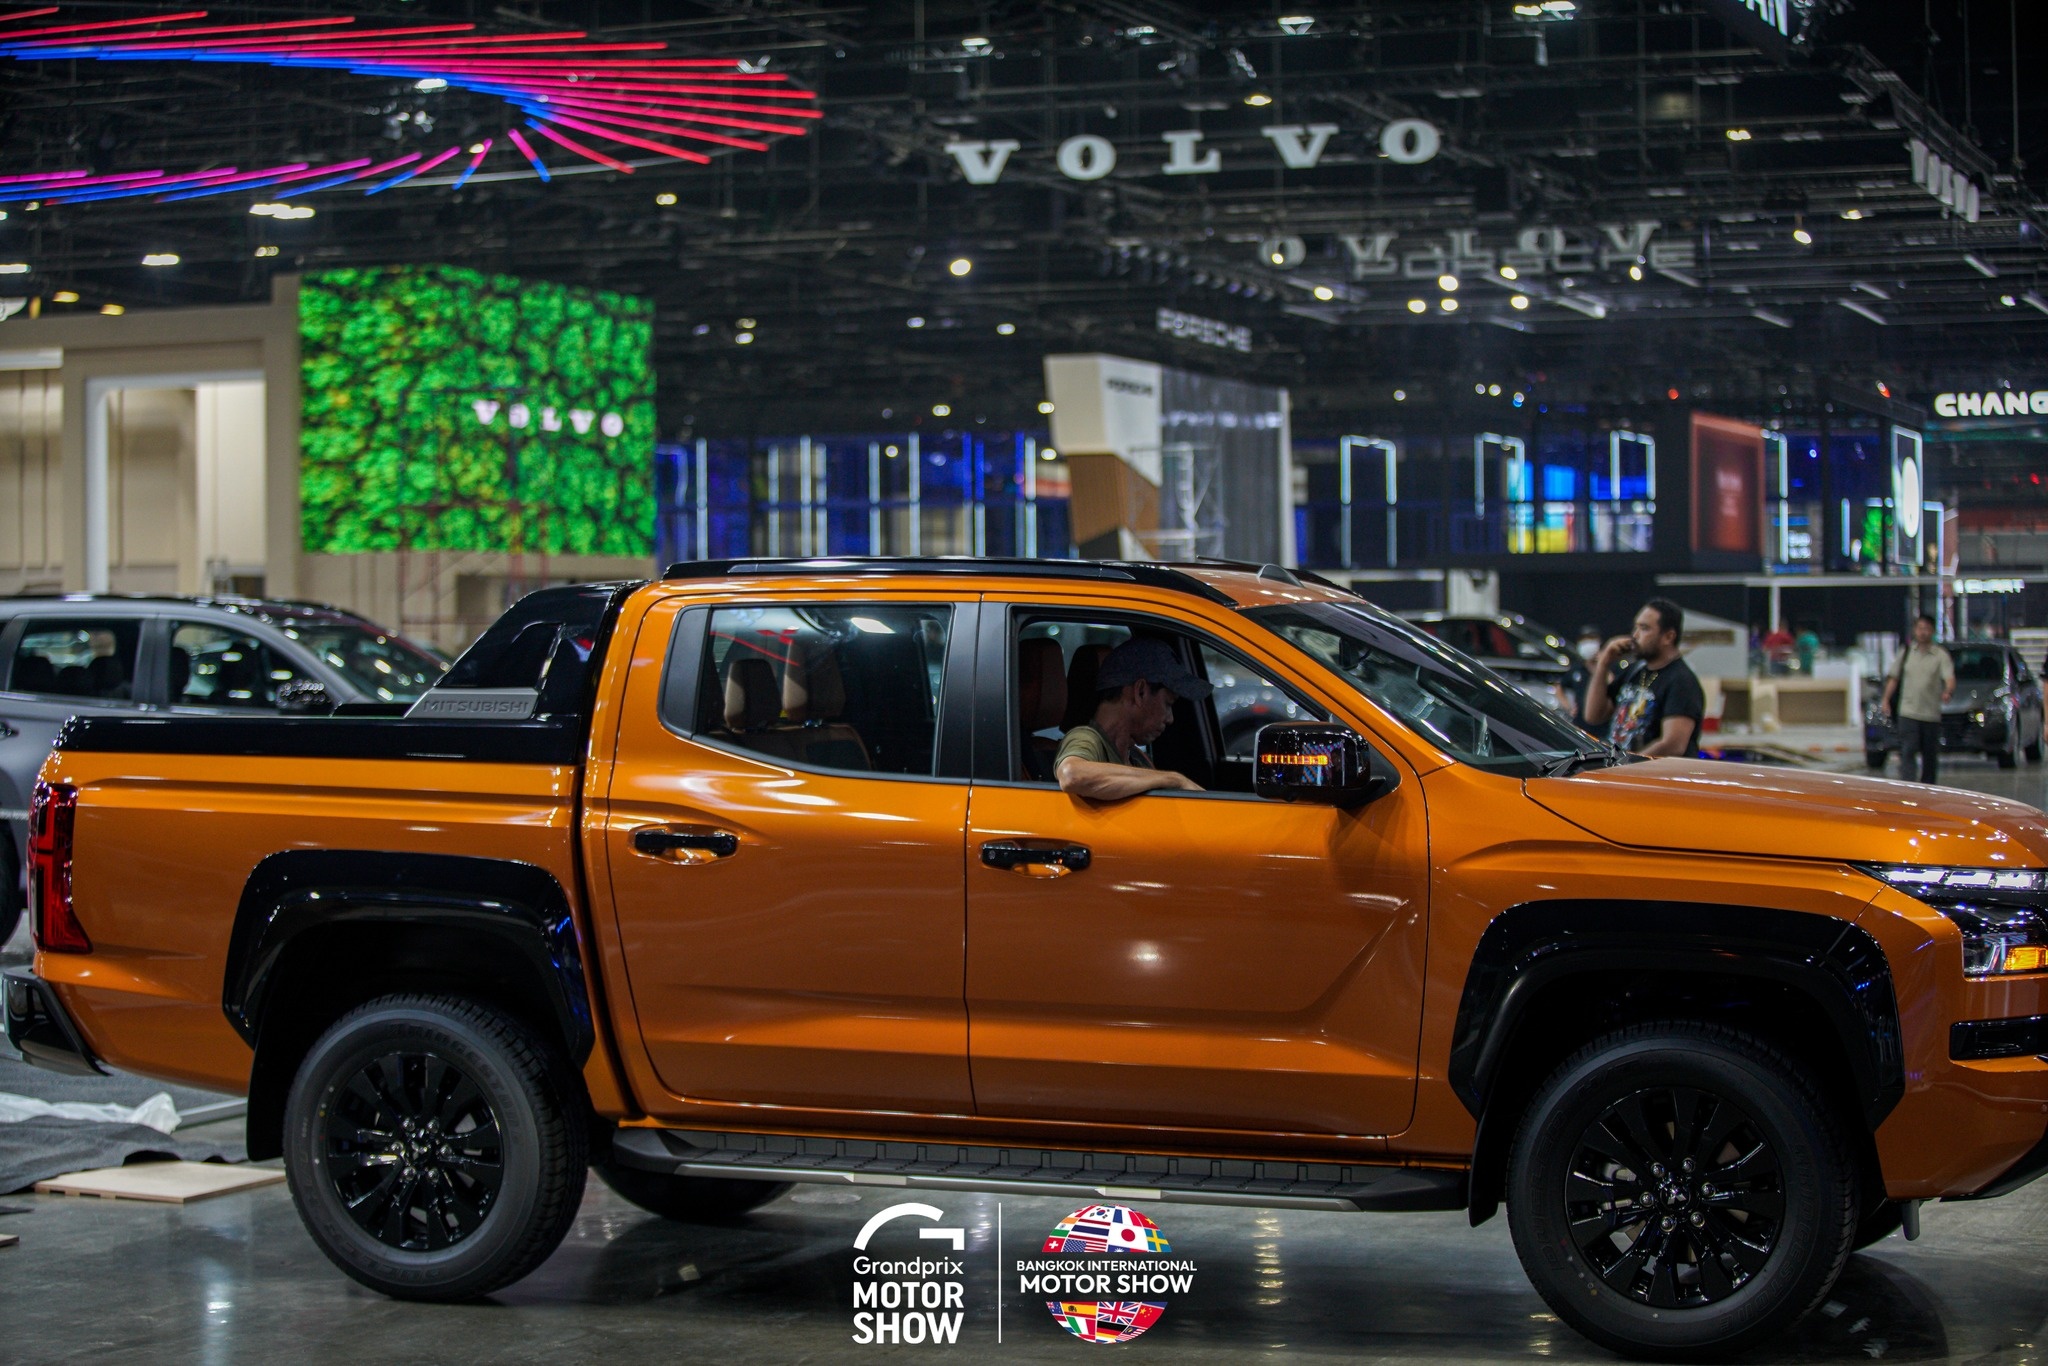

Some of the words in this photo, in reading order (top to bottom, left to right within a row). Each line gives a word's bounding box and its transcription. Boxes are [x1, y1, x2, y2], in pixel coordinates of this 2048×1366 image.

[944, 119, 1441, 185] VOLVO
[472, 399, 624, 437] VOLVO
[1934, 390, 2048, 417] CHANG
[424, 700, 528, 713] MITSUBISHI
